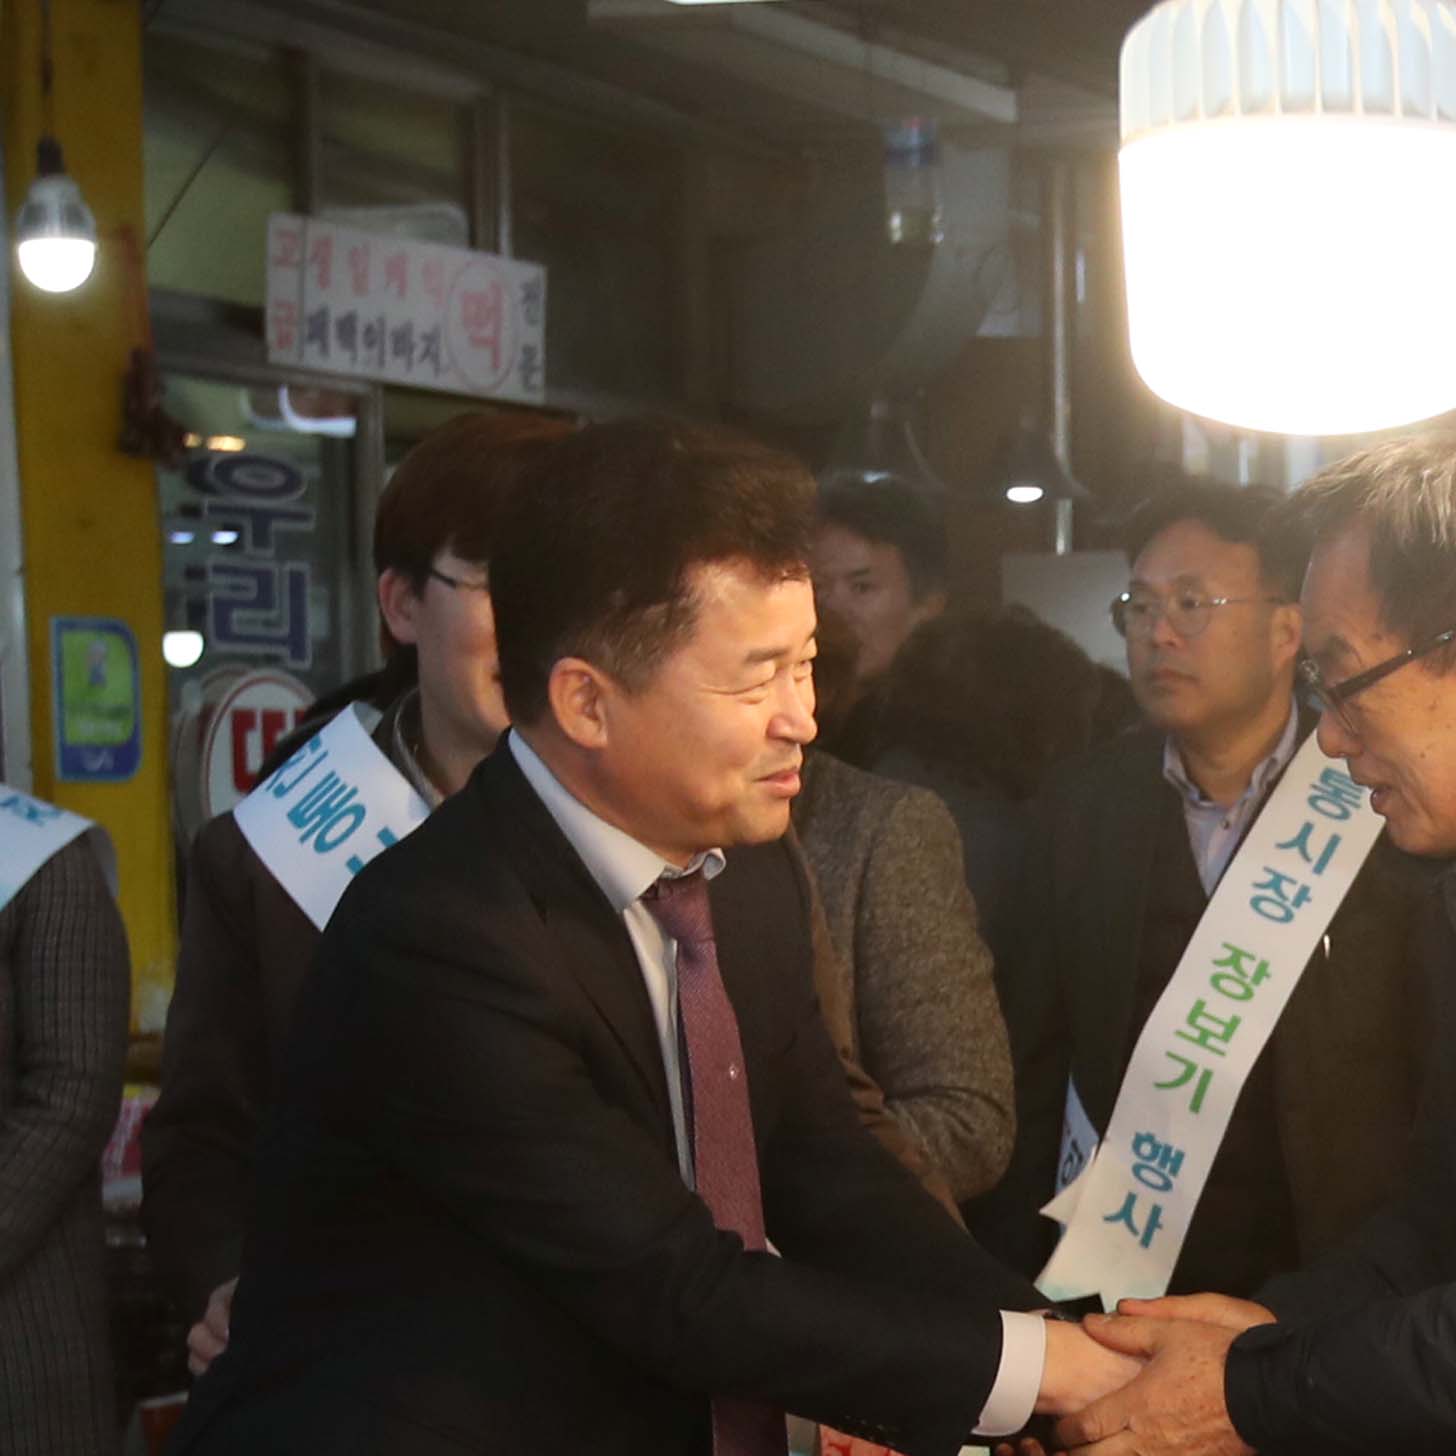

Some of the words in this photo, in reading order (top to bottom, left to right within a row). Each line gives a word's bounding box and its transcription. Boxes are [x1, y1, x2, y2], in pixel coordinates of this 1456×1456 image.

[206, 454, 315, 671] 우리
[1153, 941, 1272, 1115] 장보기
[1102, 1130, 1186, 1249] 행사
